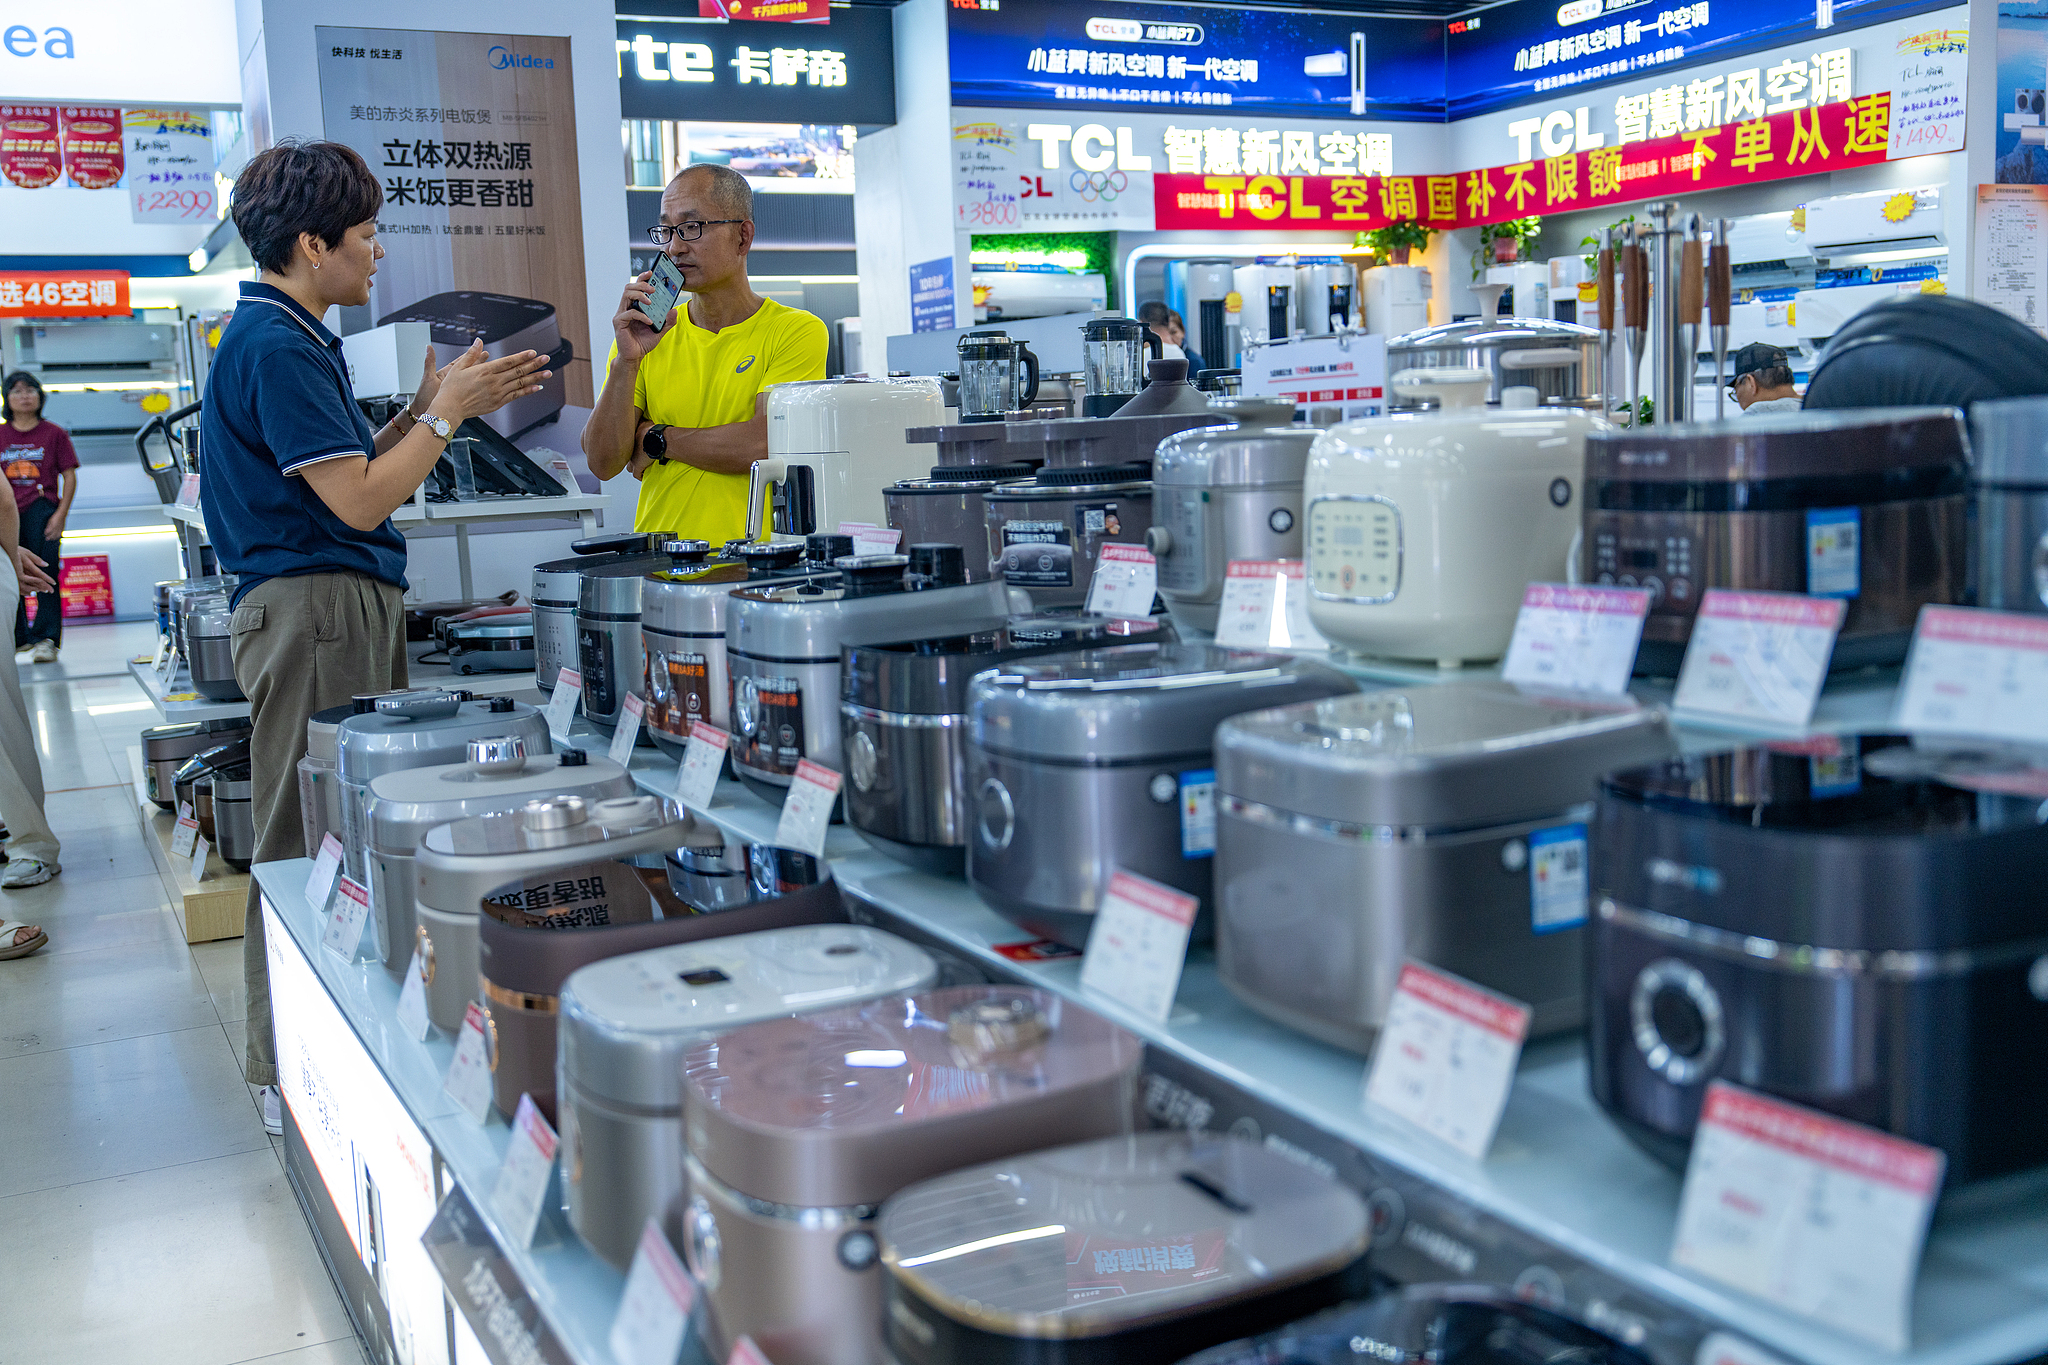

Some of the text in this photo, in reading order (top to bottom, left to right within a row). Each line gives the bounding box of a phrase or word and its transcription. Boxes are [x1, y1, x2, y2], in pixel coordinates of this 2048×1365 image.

[1094, 25, 1117, 34] TCL
[1514, 2, 1709, 72] 小蓝翼新风空调 新一代空调
[332, 46, 403, 60] 快科技 悦生活
[490, 47, 554, 70] Midea
[729, 45, 848, 87] 卡萨帝
[1028, 48, 1259, 83] 小蓝翼新风空调 新一代空调
[350, 104, 492, 125] 美的赤炎系列电饭煲
[1508, 106, 1604, 163] TCL
[1614, 47, 1852, 146] 智慧新风空调
[382, 138, 534, 171] 立体双热源
[1028, 123, 1152, 172] TCL
[1164, 125, 1394, 177] 智慧新风空调
[385, 175, 535, 208] 米饭更香甜
[495, 225, 547, 237] 五星好米饭
[0, 279, 118, 308] 选46空调
